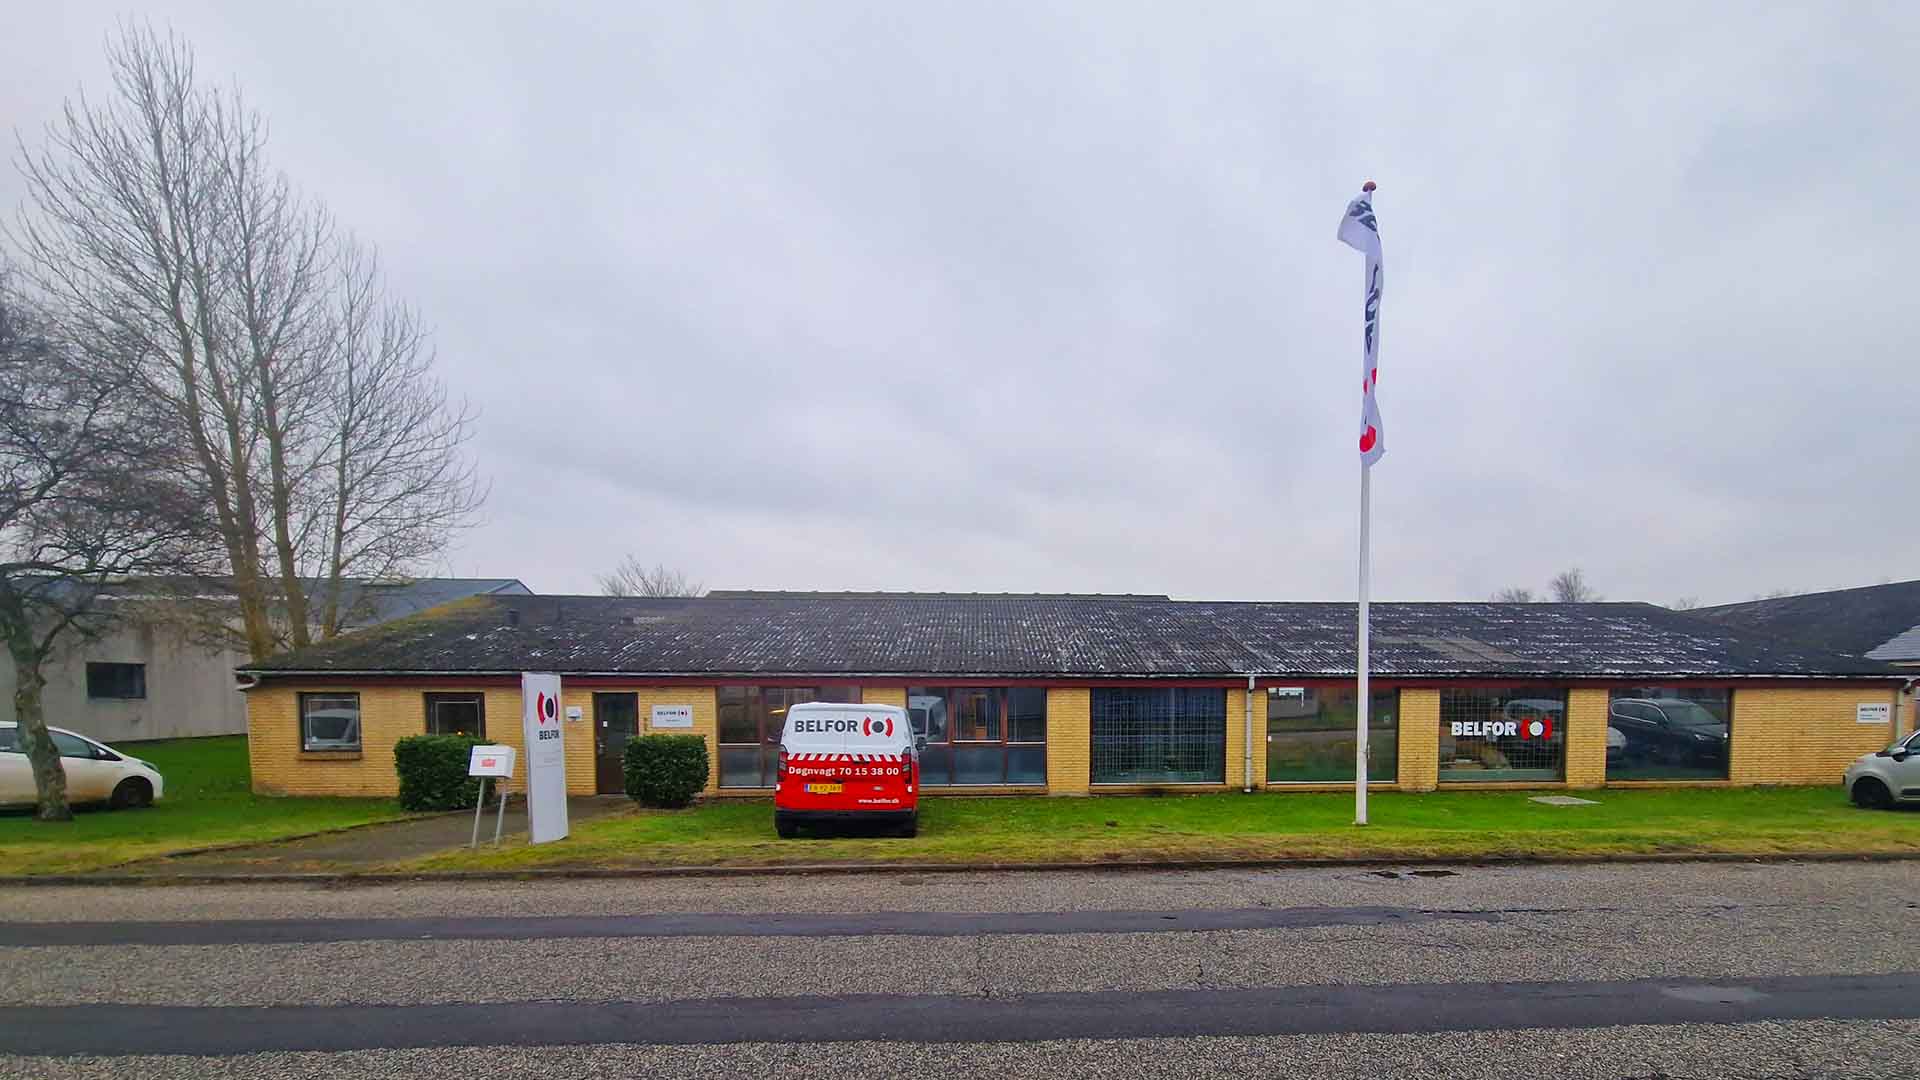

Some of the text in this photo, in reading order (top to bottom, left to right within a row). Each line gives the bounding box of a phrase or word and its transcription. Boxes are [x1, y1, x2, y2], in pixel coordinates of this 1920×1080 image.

[795, 720, 858, 732] BELFOR
[1451, 721, 1517, 736] BELFOR
[788, 766, 899, 776] Døgnvagt 70 15 38 00
